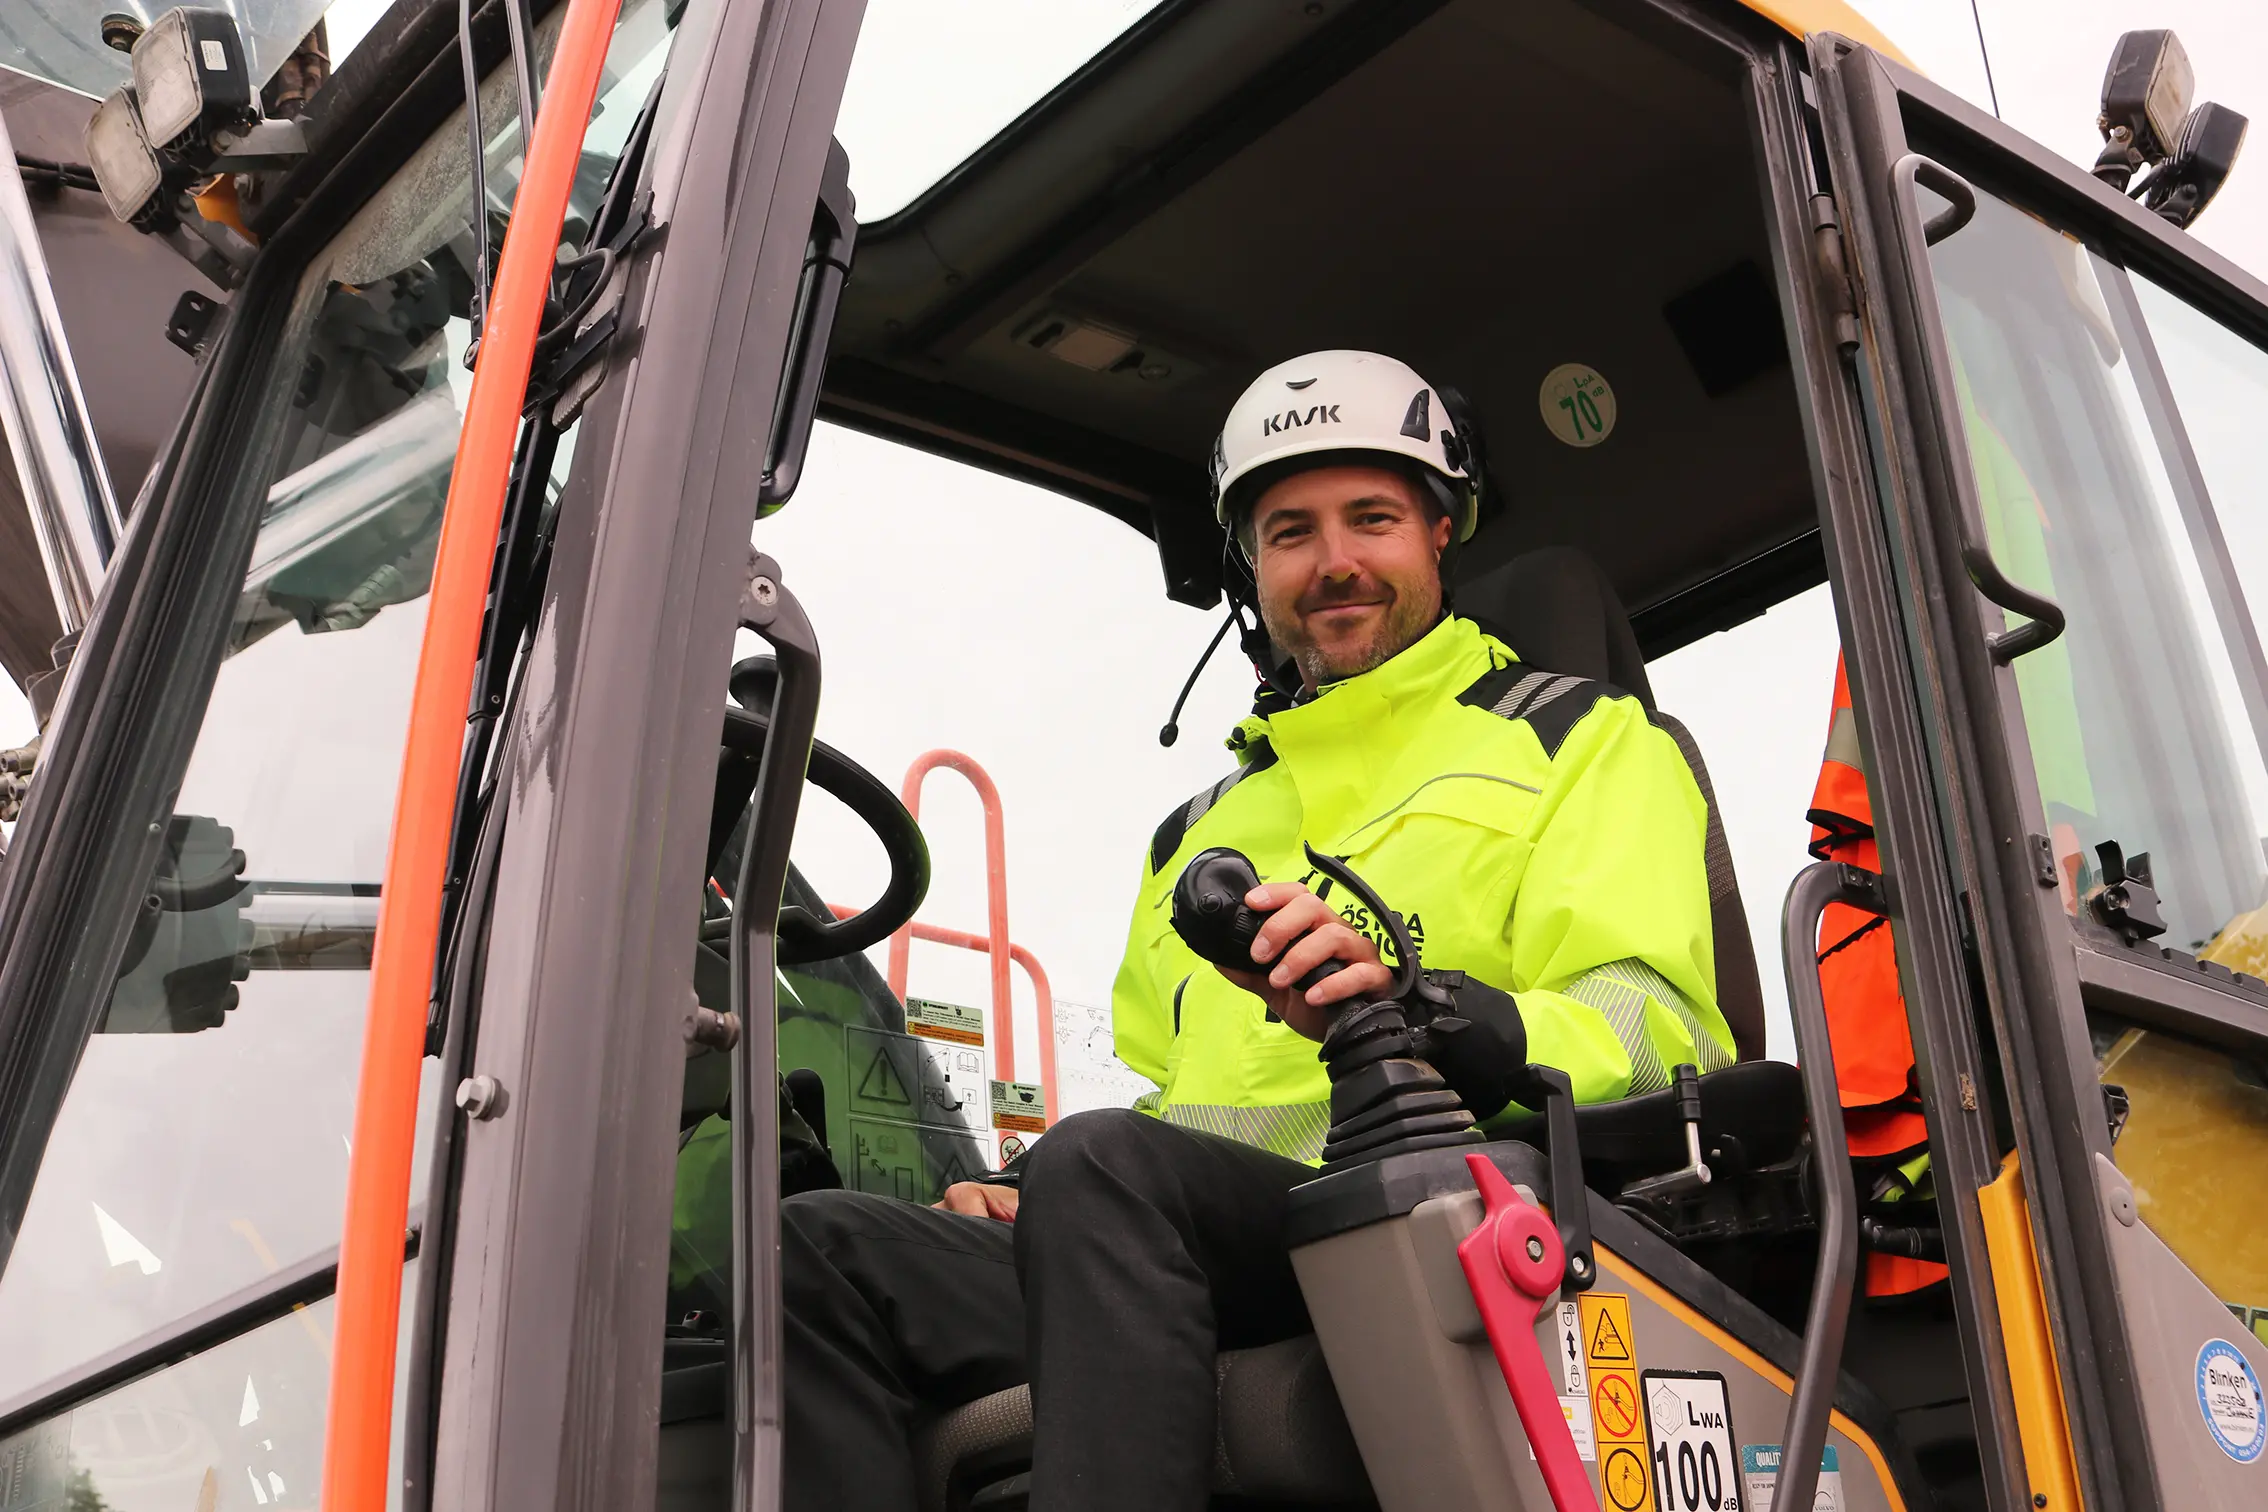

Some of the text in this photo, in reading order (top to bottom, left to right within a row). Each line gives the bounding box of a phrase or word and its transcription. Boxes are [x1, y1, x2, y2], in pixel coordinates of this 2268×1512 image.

[1264, 405, 1342, 437] KASK
[1559, 386, 1605, 441] 70 dB
[2209, 1368, 2247, 1389] Blinken
[1687, 1400, 1724, 1429] LWA
[1656, 1440, 1738, 1512] 100 dB
